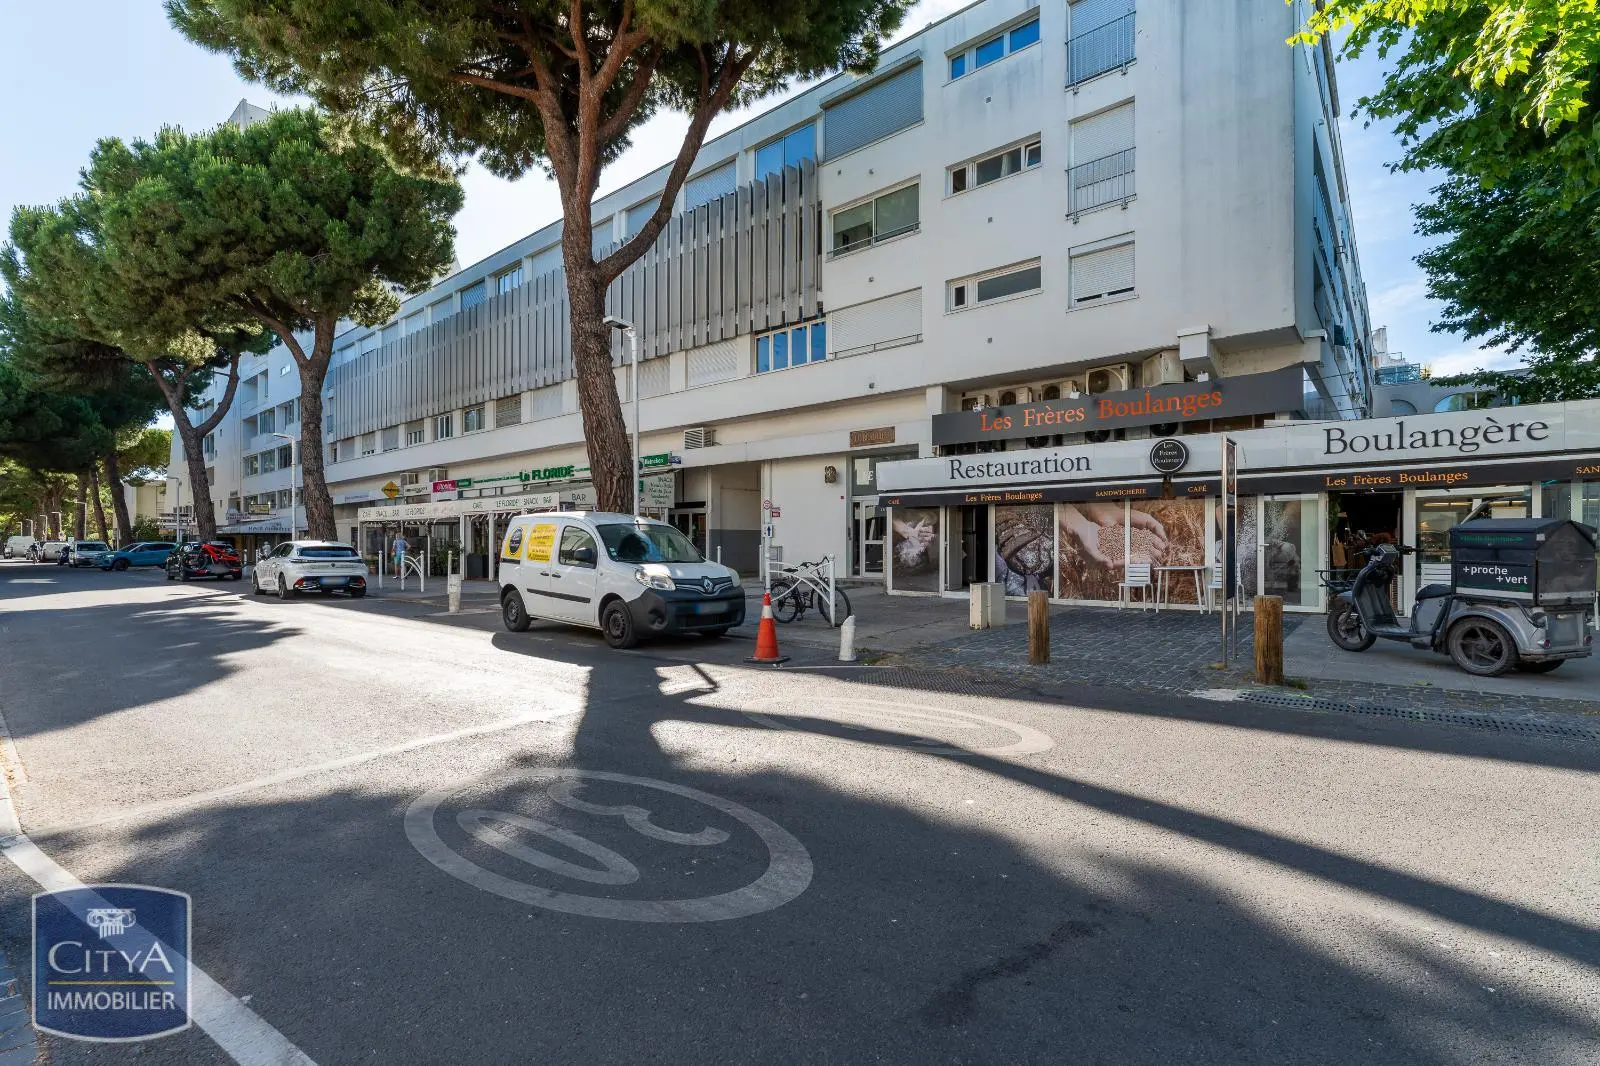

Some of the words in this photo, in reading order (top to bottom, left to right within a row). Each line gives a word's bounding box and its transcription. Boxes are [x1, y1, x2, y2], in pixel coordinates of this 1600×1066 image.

[980, 412, 1012, 432] Les
[1023, 406, 1085, 428] Frères
[1098, 389, 1224, 420] Boulanges
[1323, 416, 1550, 455] Boulangère
[519, 471, 530, 482] Le
[531, 465, 575, 481] FLORIDE
[949, 452, 1092, 481] Restauration
[1325, 476, 1347, 487] Les
[1352, 474, 1392, 486] Frères
[1399, 470, 1469, 484] Boulanges
[965, 495, 977, 503] Les
[980, 493, 1002, 502] Frères
[1005, 491, 1043, 501] Boulanges
[1095, 488, 1147, 497] SANDWICHERIE
[1187, 484, 1207, 493] CAFÉ
[571, 493, 586, 502] BAR
